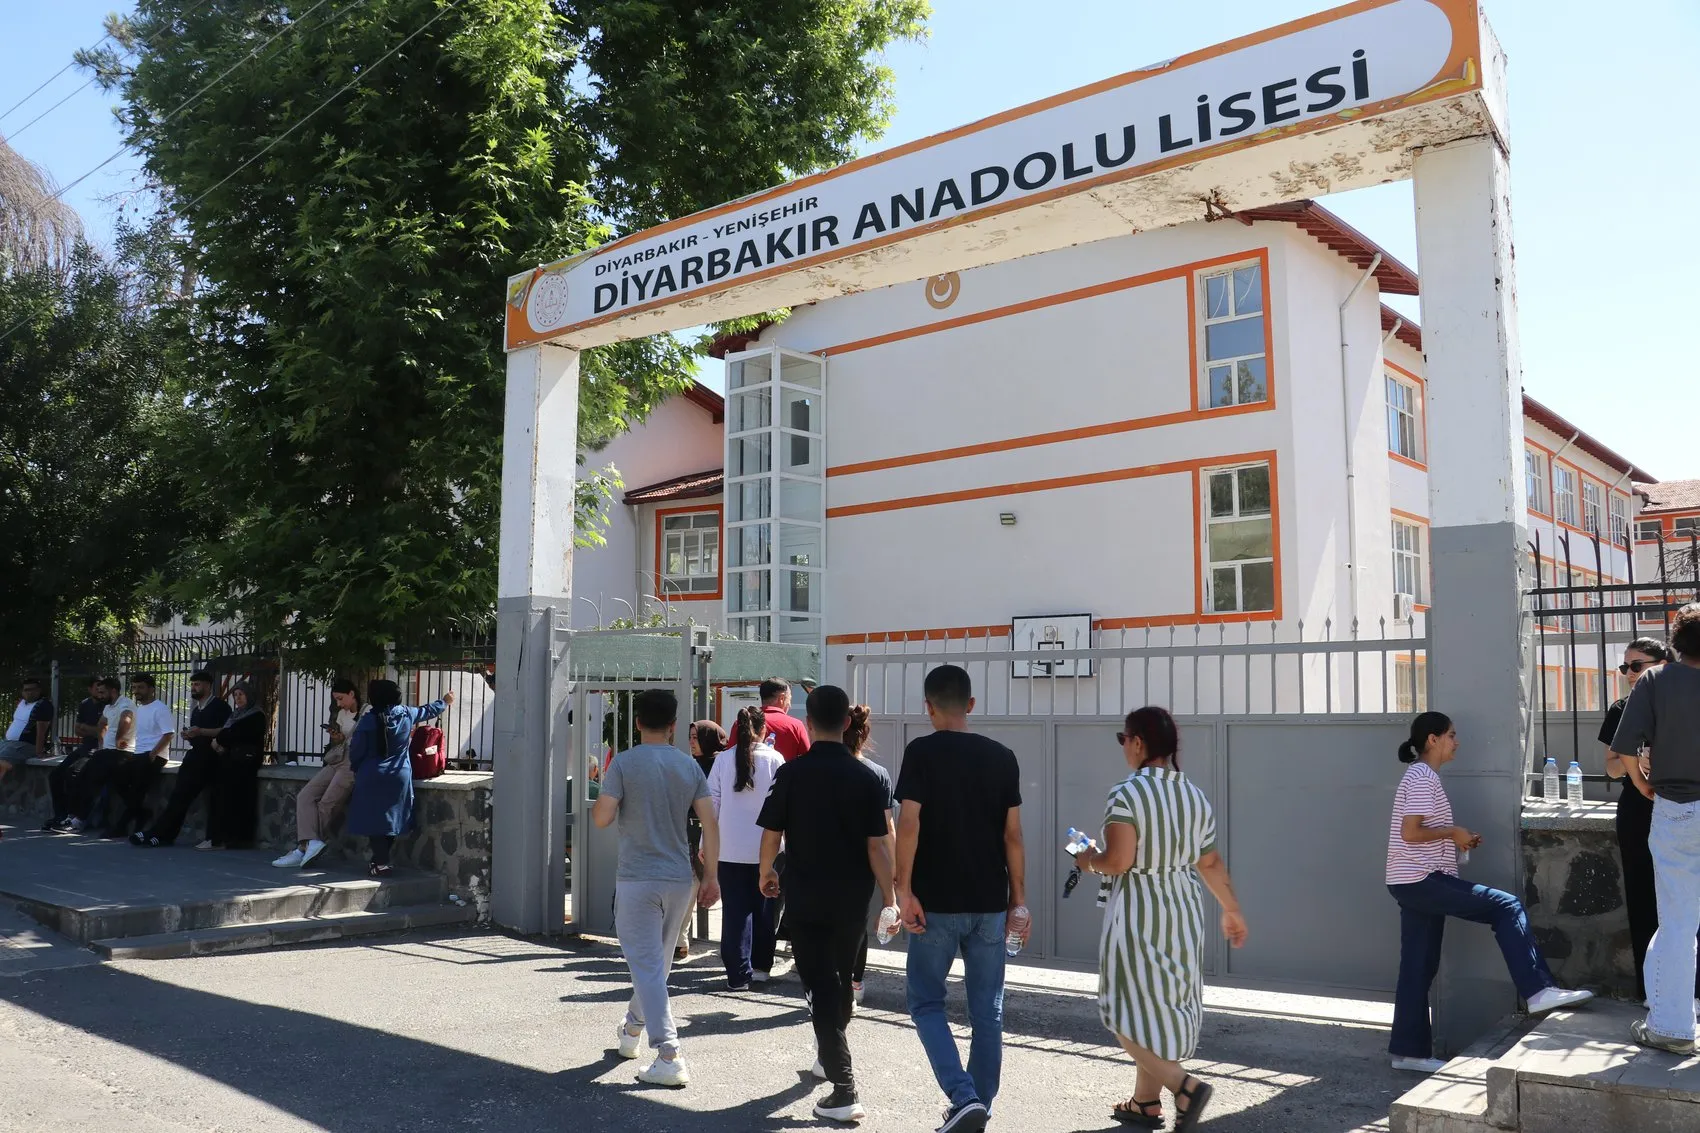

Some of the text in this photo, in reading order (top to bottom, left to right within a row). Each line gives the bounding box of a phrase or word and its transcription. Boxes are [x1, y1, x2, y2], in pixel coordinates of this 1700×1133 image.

[593, 214, 840, 314] DİYARBAKIR
[852, 124, 1136, 241] ANADOLU
[1158, 48, 1370, 154] LİSESİ
[594, 234, 698, 277] DİYARBAKIR
[712, 195, 818, 239] YENİŞEHİR
